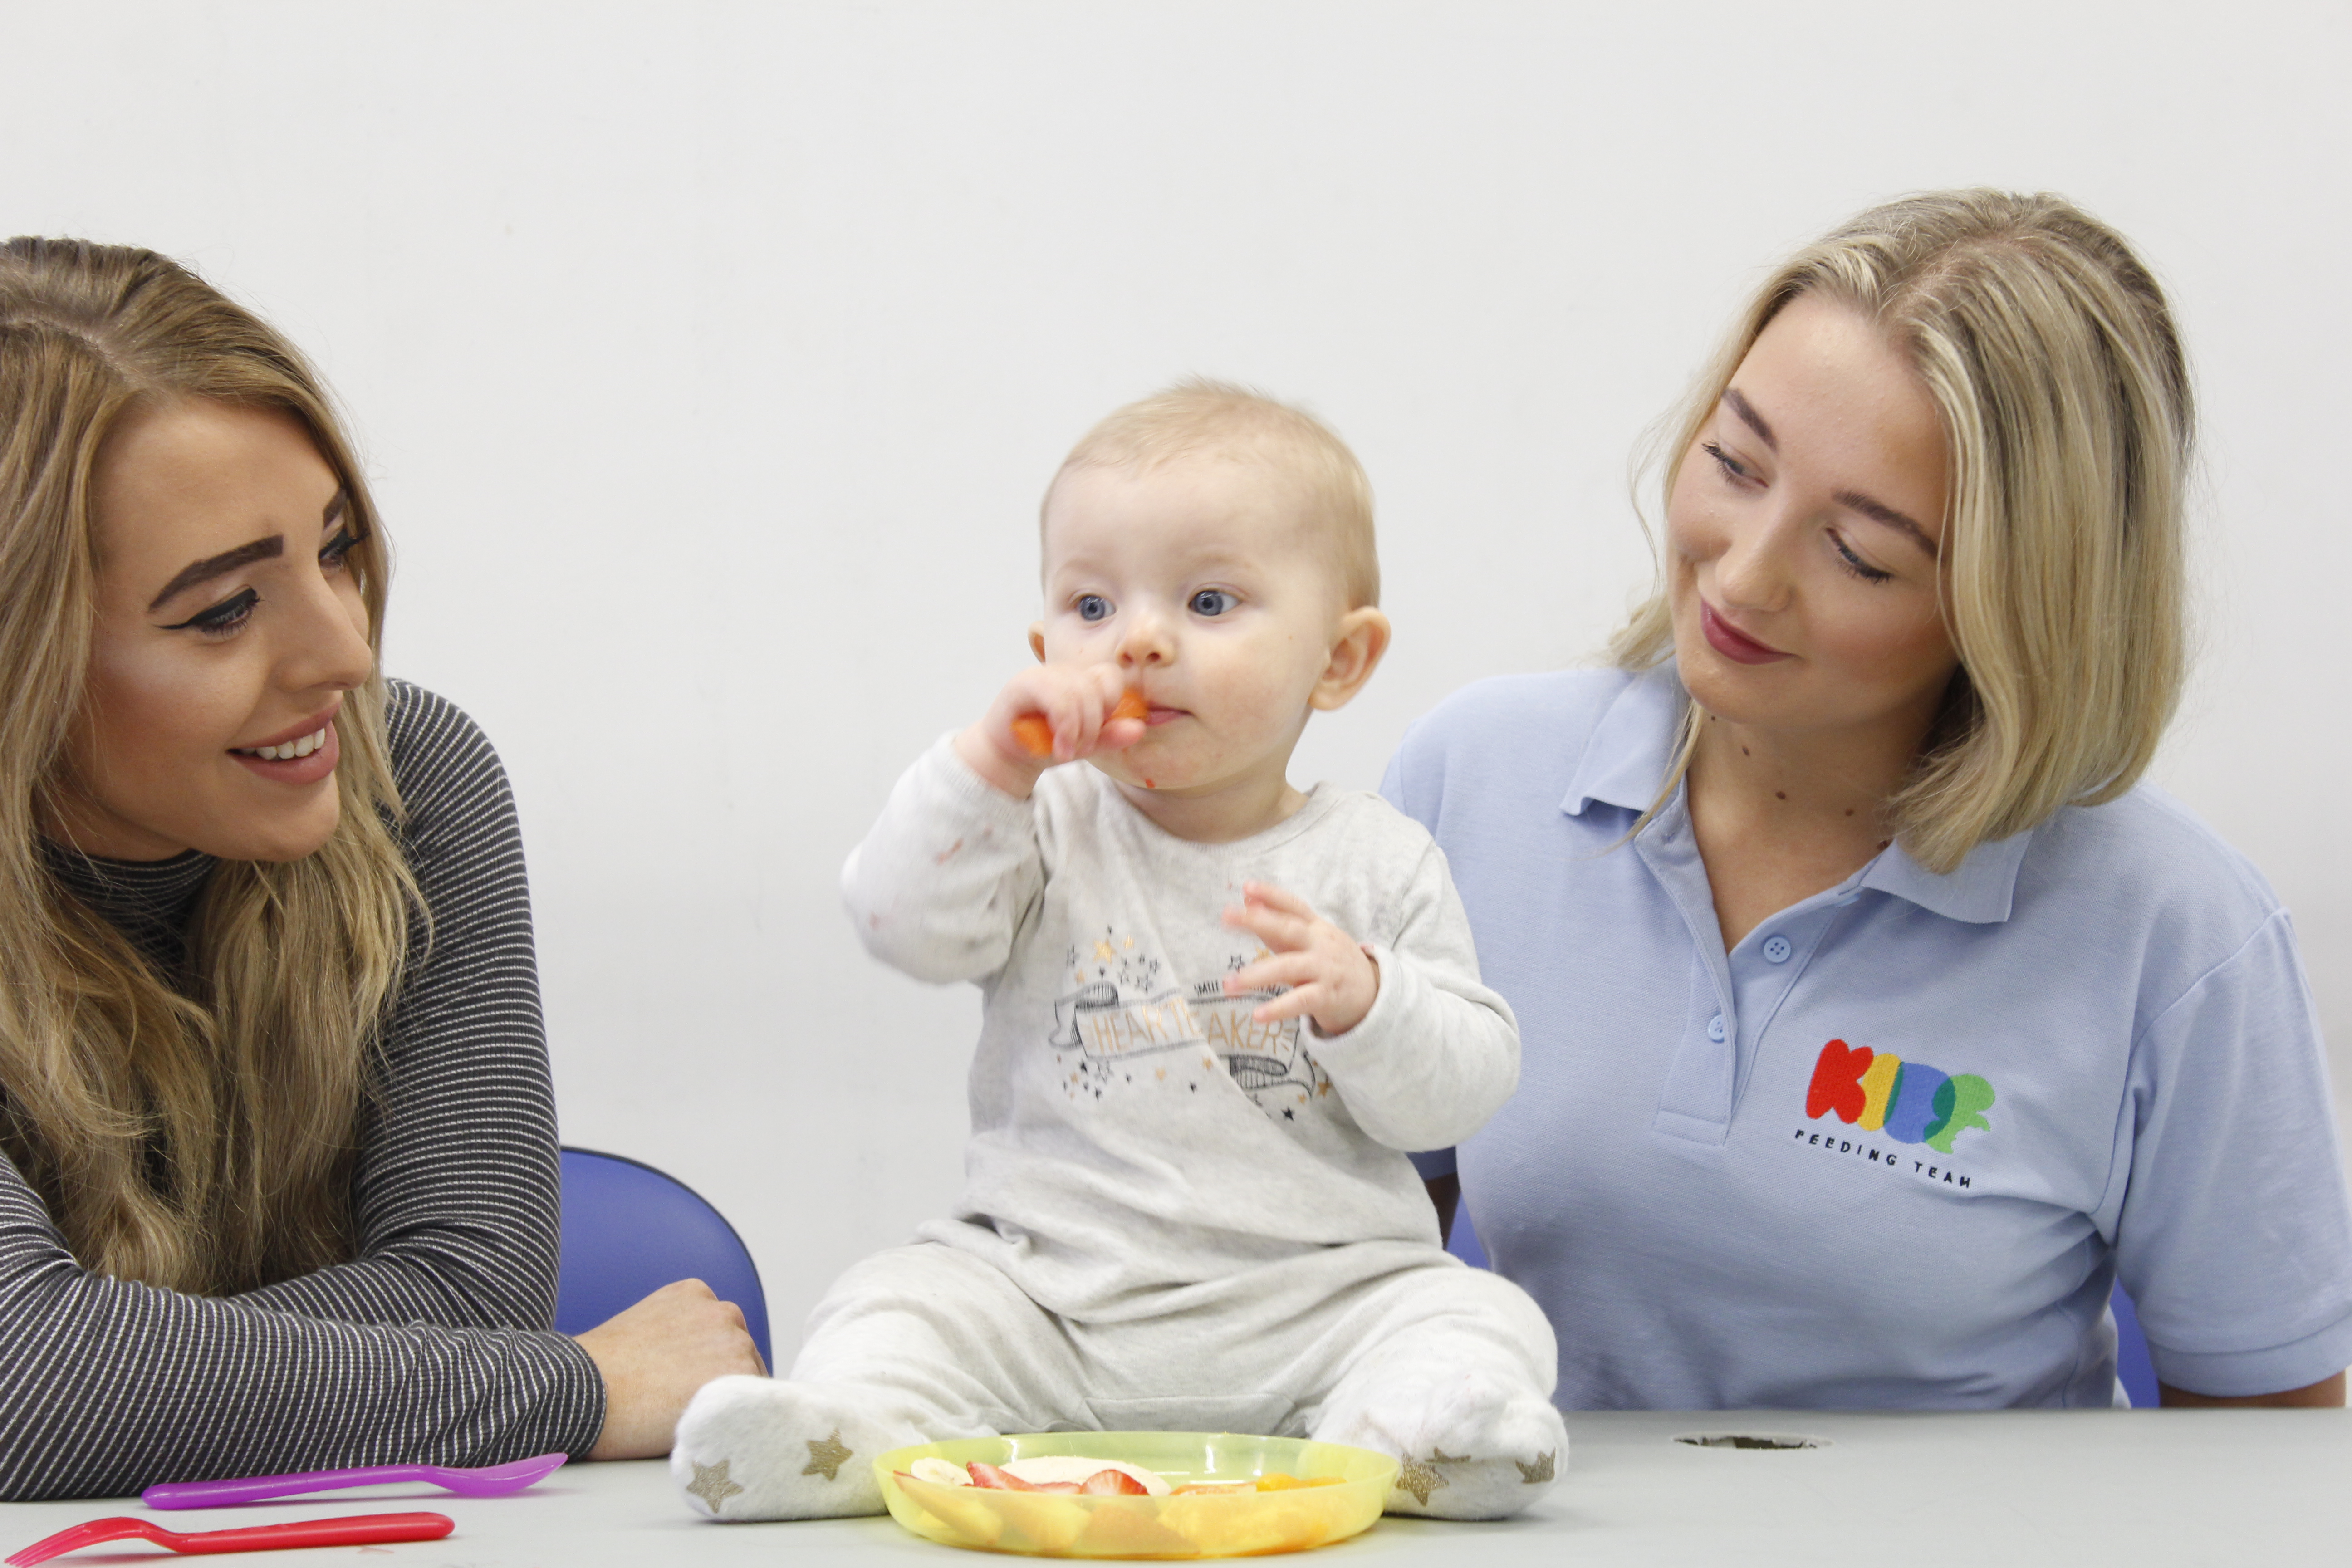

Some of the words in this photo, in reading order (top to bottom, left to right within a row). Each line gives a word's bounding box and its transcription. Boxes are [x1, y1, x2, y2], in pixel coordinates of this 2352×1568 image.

[1092, 996, 1283, 1055] HEARTAKER
[1794, 1129, 1897, 1166] FEEDING
[1914, 1161, 1971, 1189] TEAM
